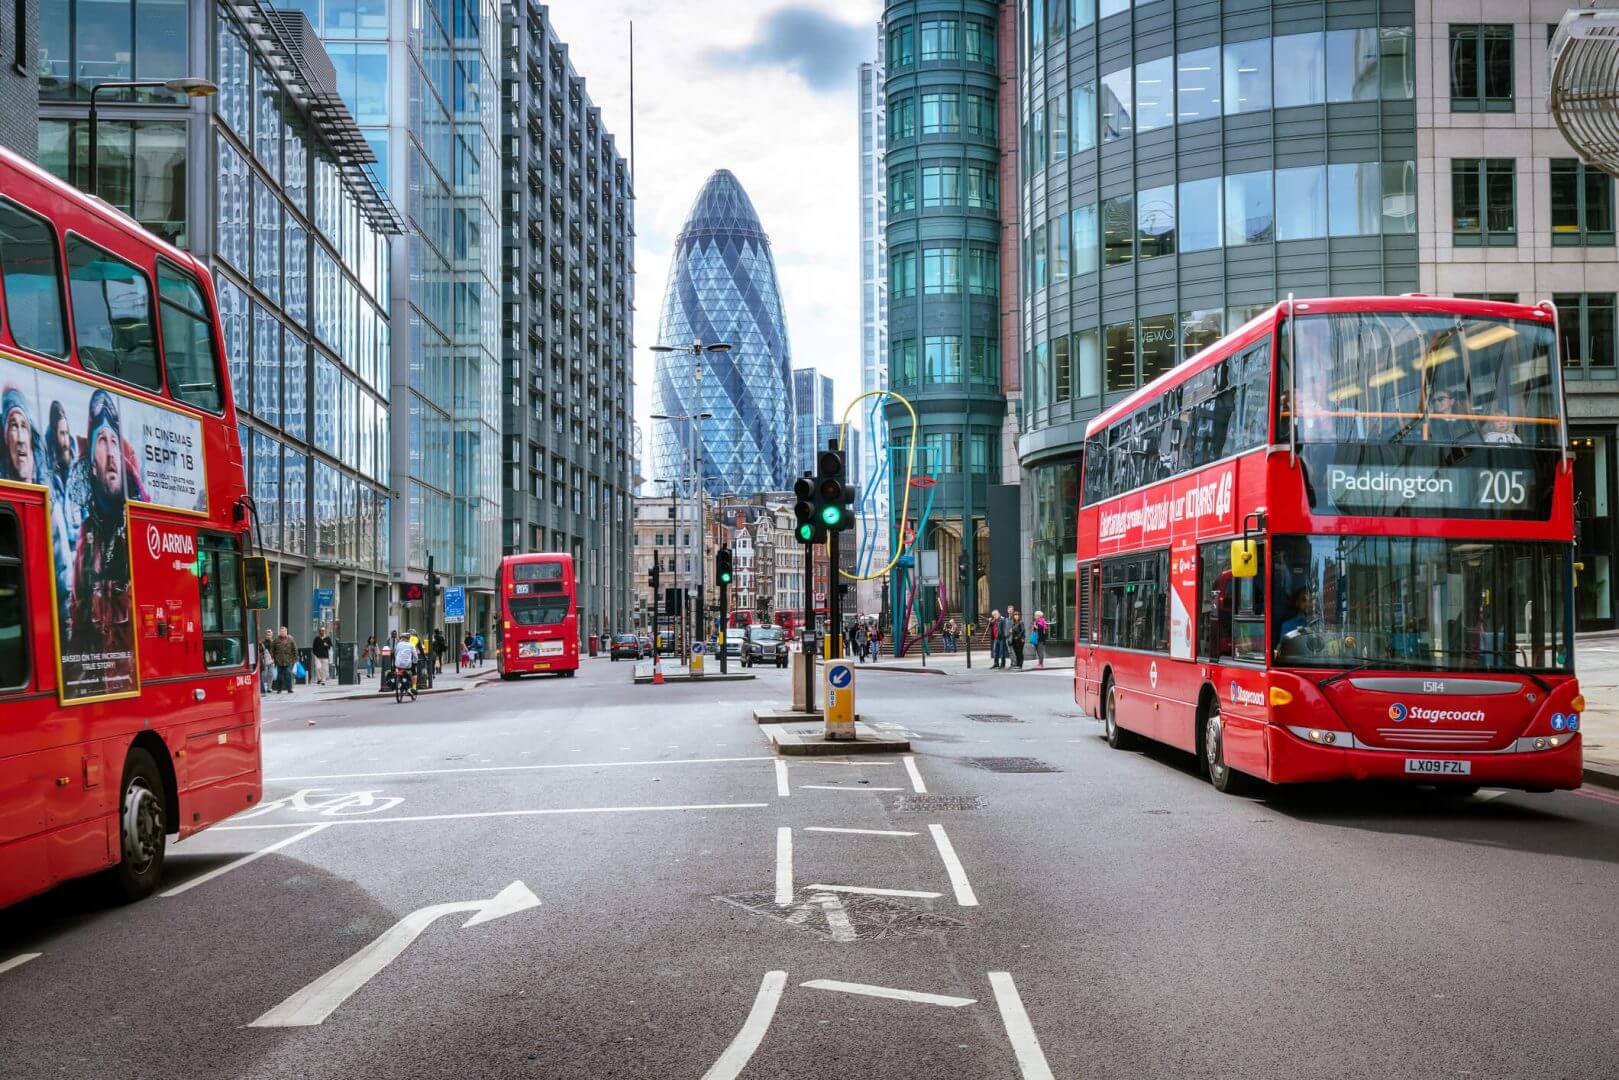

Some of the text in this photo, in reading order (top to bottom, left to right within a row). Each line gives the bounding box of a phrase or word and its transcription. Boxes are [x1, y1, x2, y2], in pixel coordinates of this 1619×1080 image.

[143, 424, 192, 448] IN CINEMAS
[145, 444, 194, 470] SEPT 18
[1216, 471, 1232, 522] 4G
[1332, 469, 1525, 504] Paddington 205
[162, 533, 194, 555] ARRIVA
[62, 654, 80, 663] BASED
[82, 662, 96, 670] TRUE
[1238, 685, 1264, 707] Stagecoach
[1409, 706, 1485, 723] Stagecoach
[1409, 760, 1465, 773] LX09 FZL
